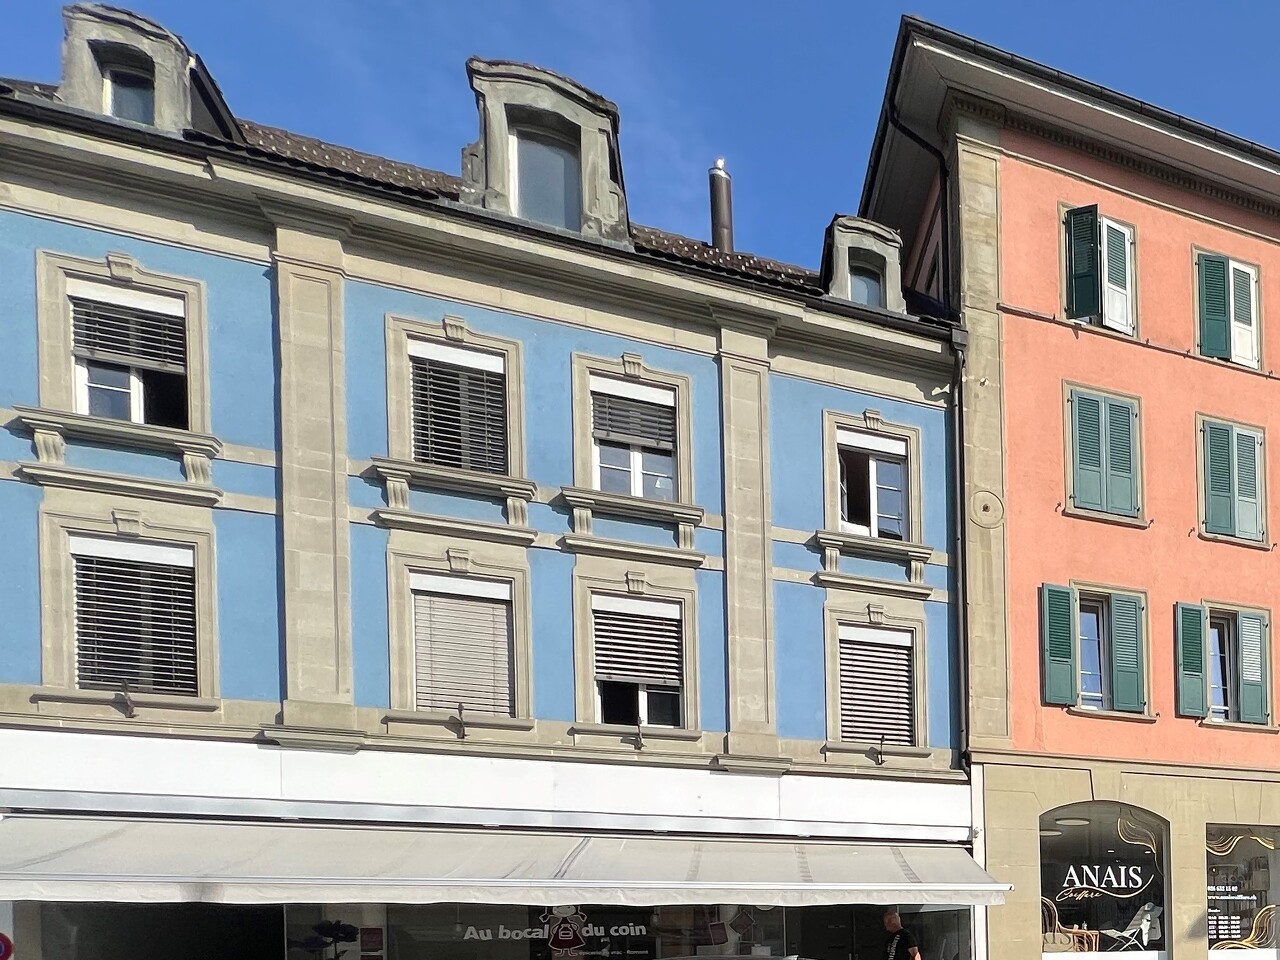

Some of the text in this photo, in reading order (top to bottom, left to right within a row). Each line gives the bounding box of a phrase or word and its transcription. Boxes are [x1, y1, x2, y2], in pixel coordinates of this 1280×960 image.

[1062, 865, 1142, 888] ANAIS
[463, 922, 647, 941] Au bocal du coin
